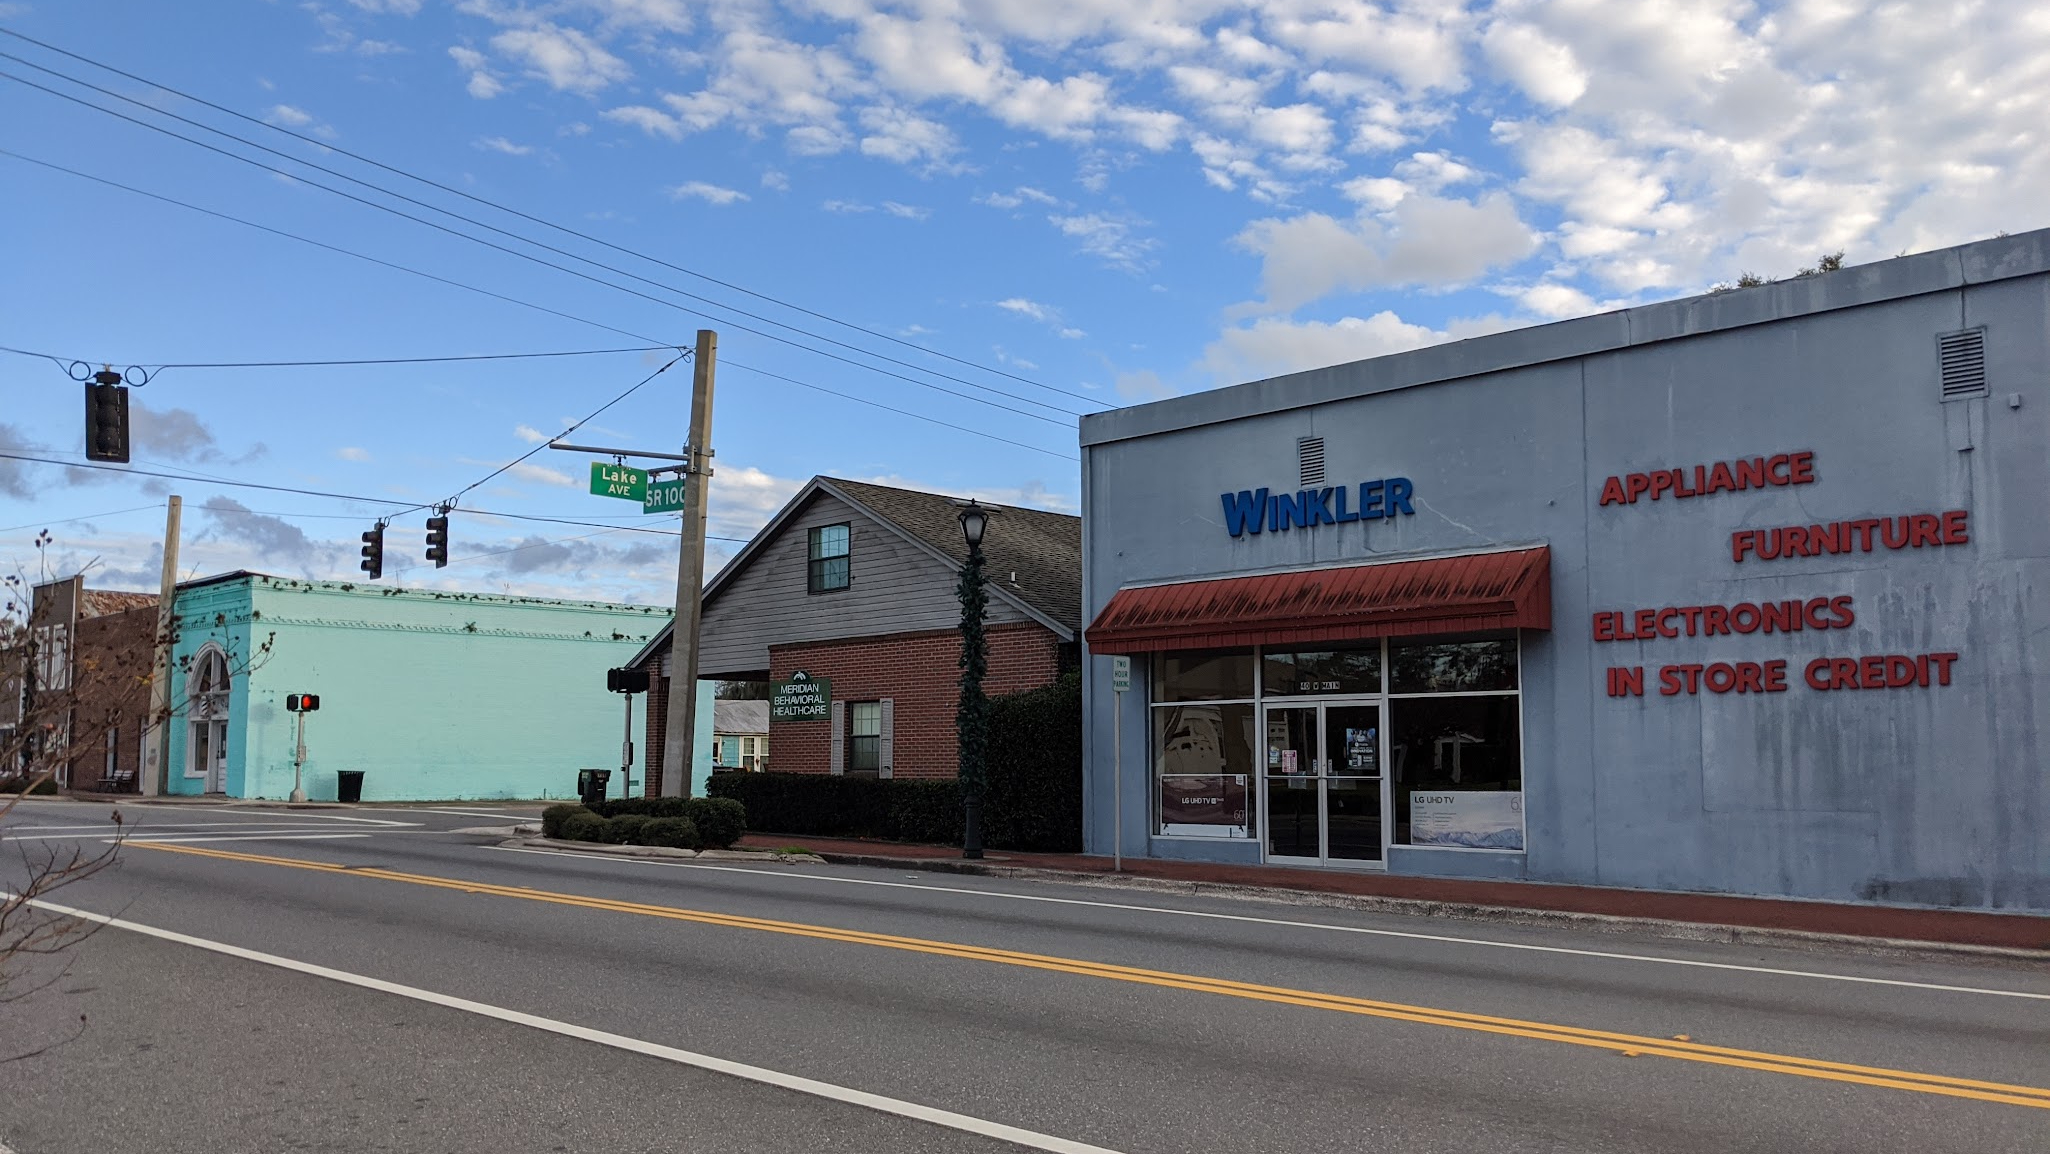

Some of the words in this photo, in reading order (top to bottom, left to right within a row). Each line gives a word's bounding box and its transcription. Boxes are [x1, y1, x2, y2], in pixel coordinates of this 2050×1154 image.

[602, 467, 637, 484] Lake
[1599, 451, 1814, 506] APPLIANCE
[608, 484, 631, 496] AVE
[645, 489, 662, 507] SR
[1731, 510, 1969, 562] FURNITURE
[1592, 595, 1855, 642] ELECTRONICS
[1116, 660, 1127, 668] TWO
[1114, 670, 1129, 678] HOUR
[1606, 666, 1643, 697] IN
[1659, 659, 1788, 696] STORE
[1804, 652, 1959, 691] CREDIT
[780, 683, 819, 694] MERIDIAN
[1113, 680, 1129, 688] PARKING
[1320, 681, 1340, 690] MAIN
[774, 694, 825, 706] BEHAVIORAL
[773, 705, 827, 716] HEALTHCARE
[1414, 796, 1425, 804] LG
[1426, 796, 1443, 804] UHD
[1444, 796, 1455, 804] TV
[1510, 796, 1522, 811] 6
